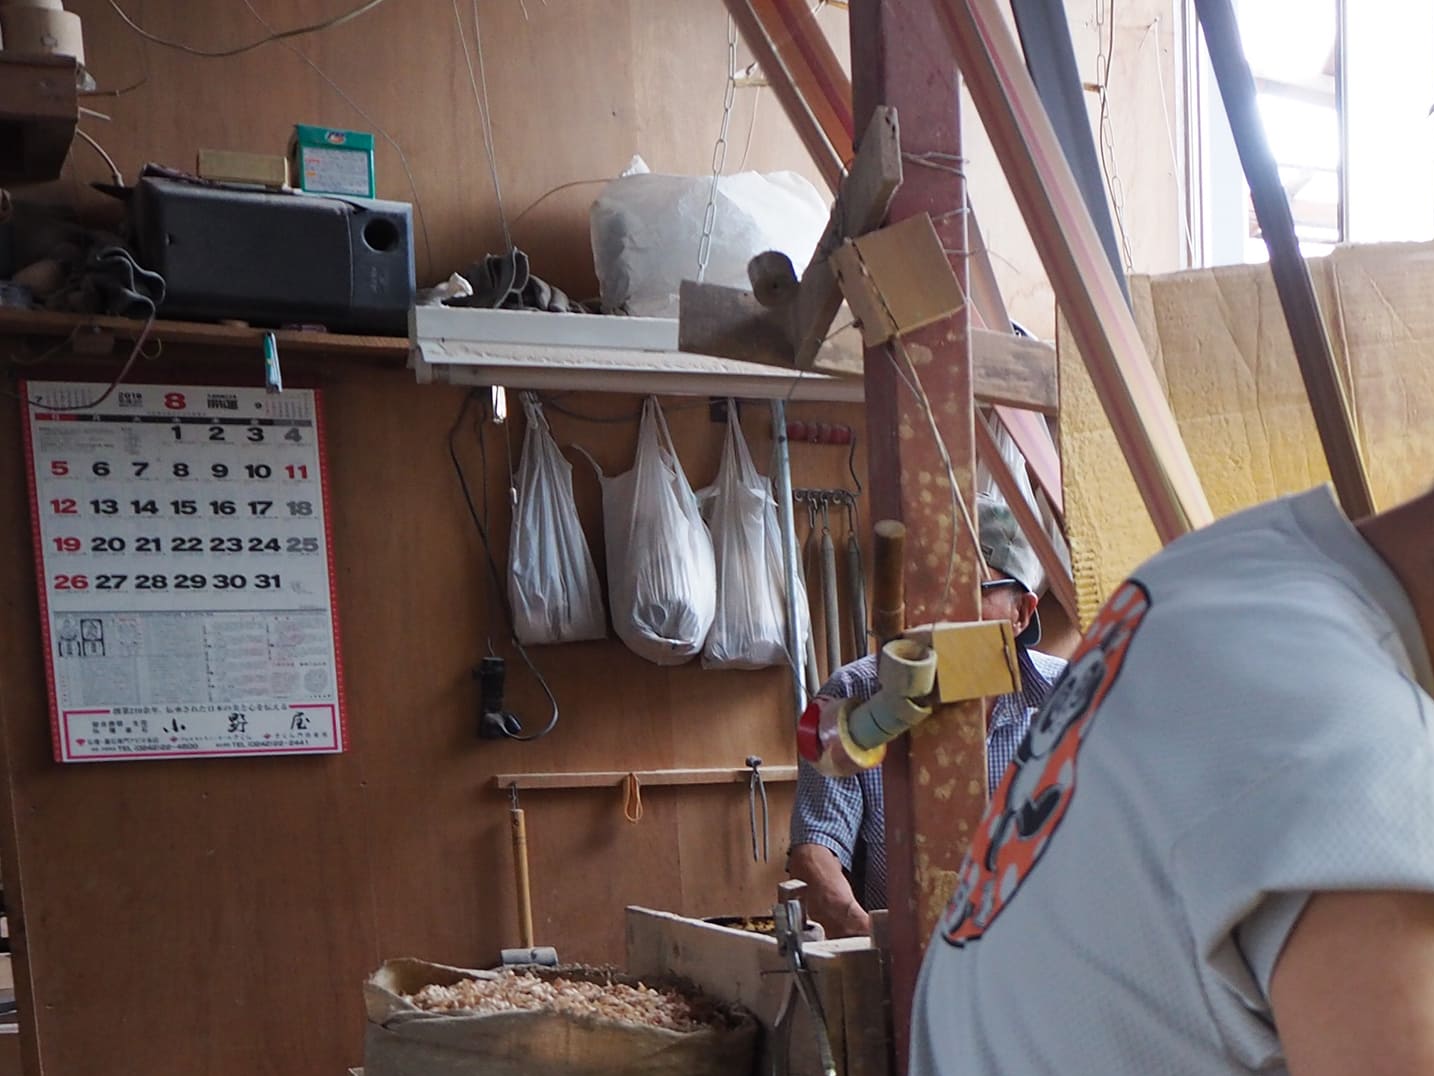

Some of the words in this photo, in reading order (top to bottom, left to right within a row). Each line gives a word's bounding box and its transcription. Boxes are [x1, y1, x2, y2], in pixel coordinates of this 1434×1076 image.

[165, 393, 186, 409] 8
[171, 425, 183, 440] 1
[208, 426, 226, 441] 2
[247, 426, 264, 442] 3
[284, 427, 302, 443] 4
[51, 460, 68, 476] 5
[92, 461, 110, 477] 6
[131, 461, 148, 477] 7
[172, 462, 189, 478] 8
[211, 463, 228, 479] 9
[244, 464, 271, 479] 10
[285, 464, 307, 480] 11
[50, 498, 77, 514] 12
[89, 499, 118, 515] 13
[130, 499, 158, 515] 14
[170, 500, 197, 515] 15
[209, 500, 236, 516] 16
[247, 500, 273, 516] 17
[285, 500, 312, 517] 18
[53, 537, 80, 553] 19
[91, 536, 125, 552] 20
[135, 536, 161, 552] 21
[171, 537, 203, 552] 22
[209, 537, 243, 553] 23
[248, 537, 281, 552] 24
[286, 537, 318, 553] 25
[54, 574, 88, 590] 26
[95, 574, 127, 590] 27
[135, 574, 167, 590] 28
[173, 574, 206, 589] 29
[212, 574, 246, 590] 30
[254, 574, 280, 589] 31
